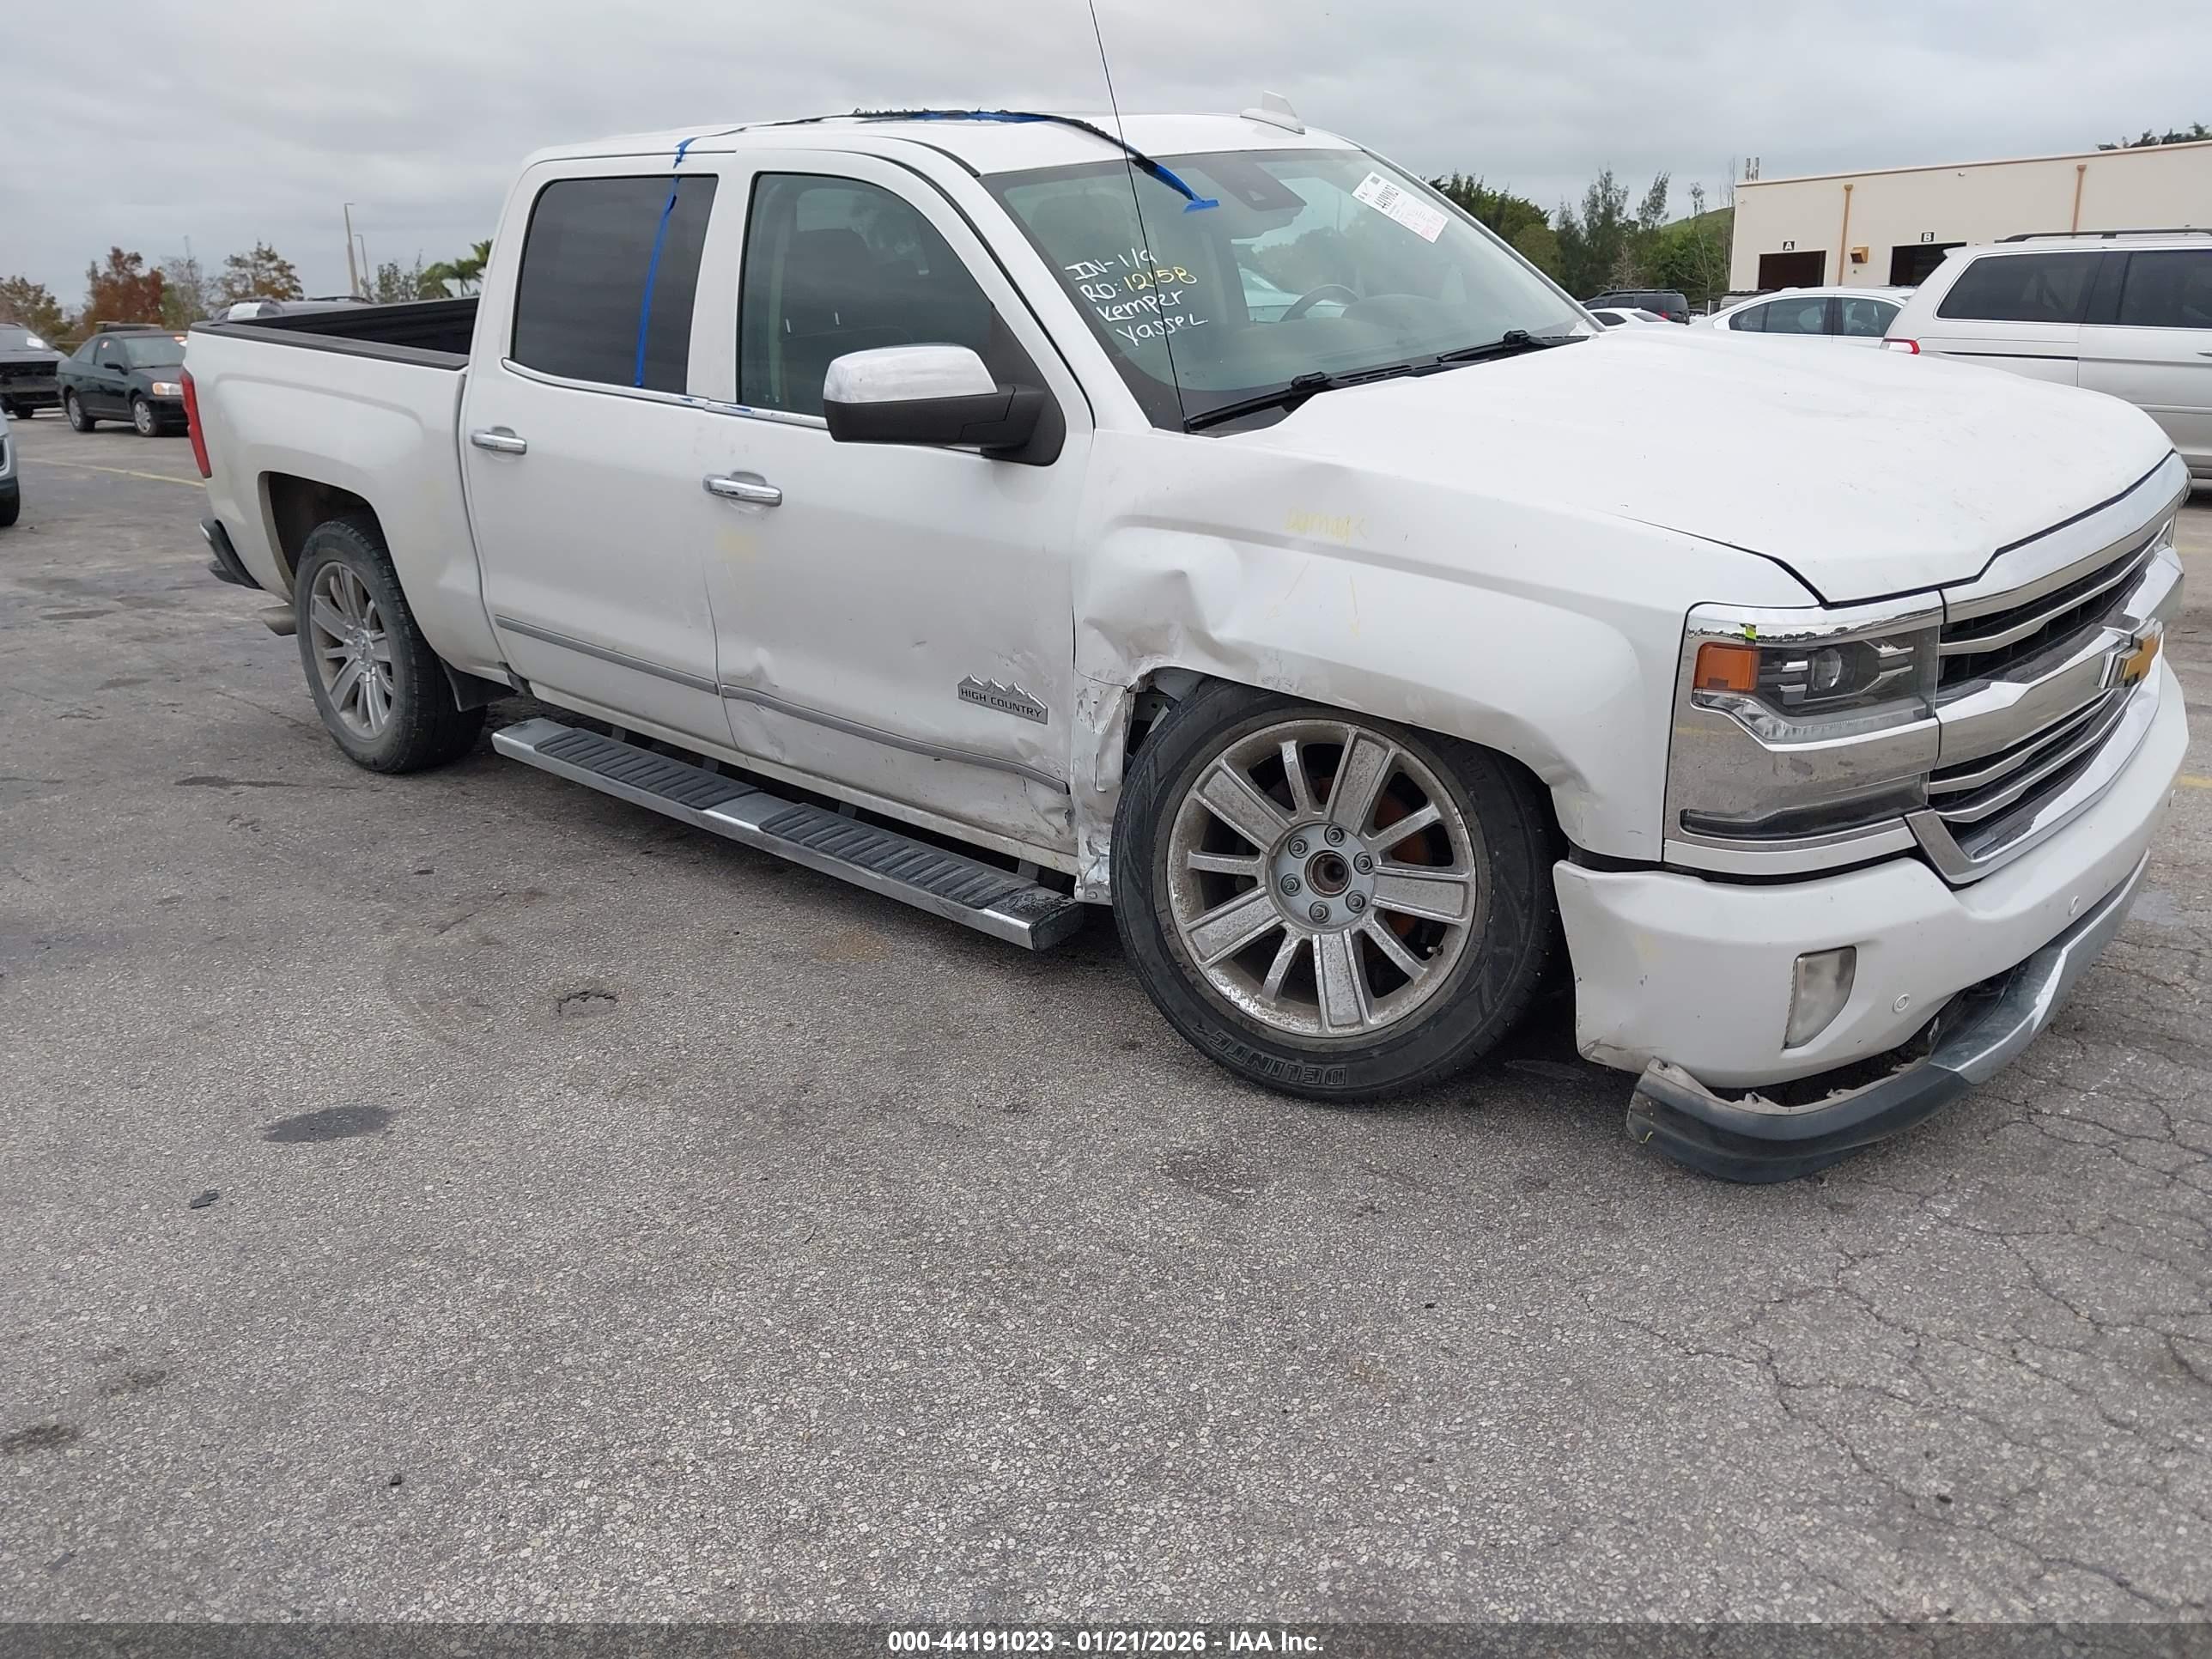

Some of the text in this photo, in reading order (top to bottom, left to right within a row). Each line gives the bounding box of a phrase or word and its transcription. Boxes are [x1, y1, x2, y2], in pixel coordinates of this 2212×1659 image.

[961, 688, 1042, 718] HIGH COUNTRY
[1208, 1031, 1346, 1086] DELINTE
